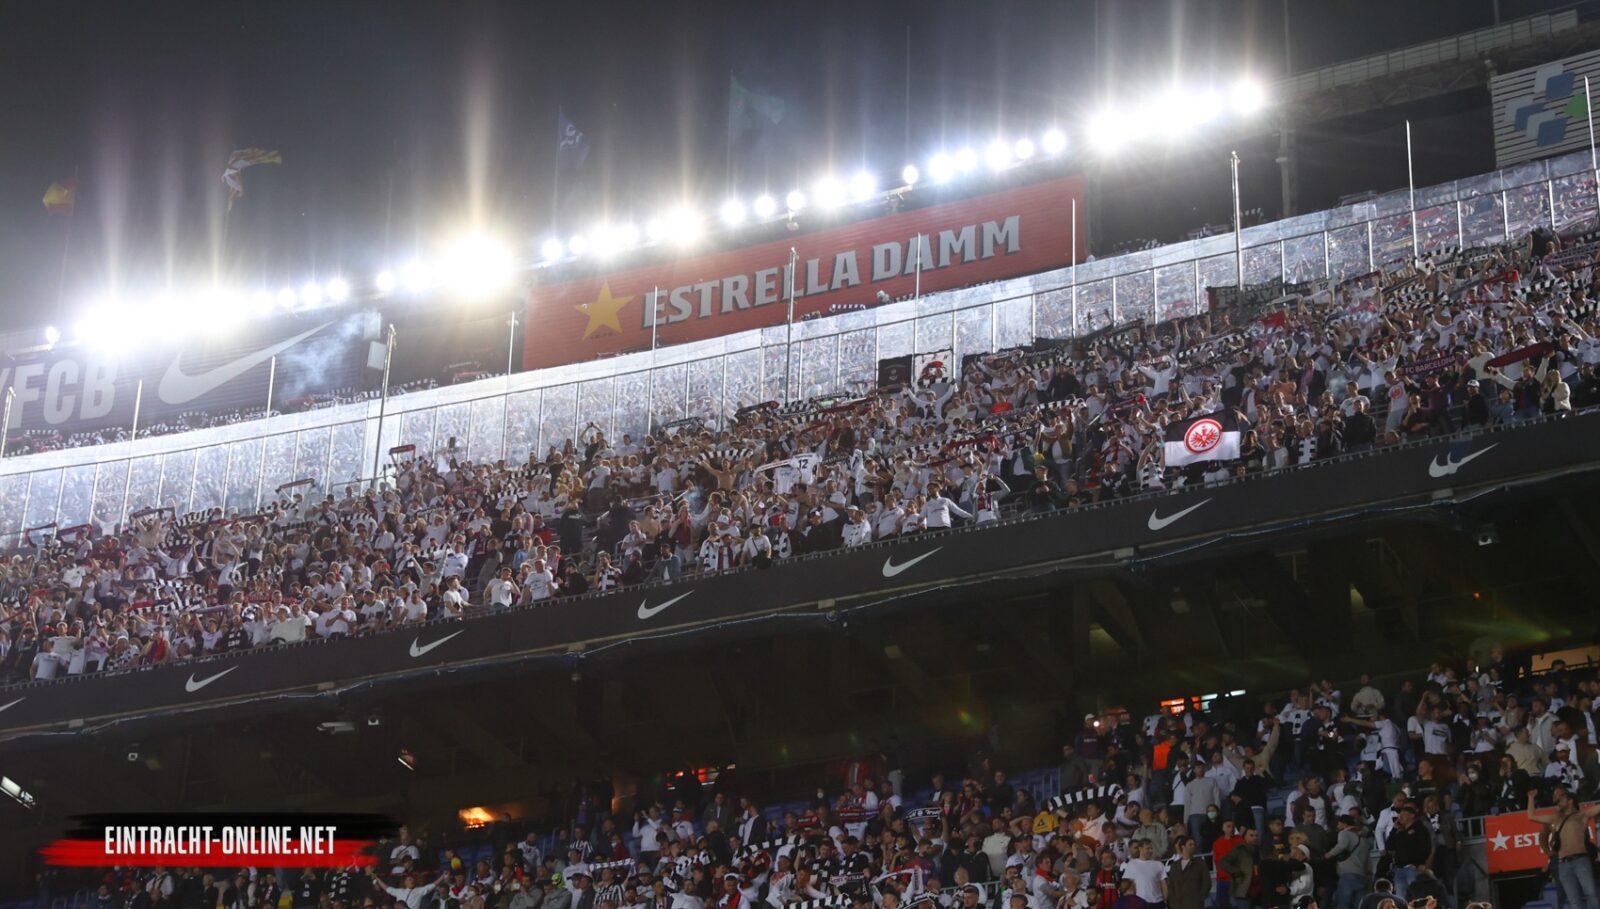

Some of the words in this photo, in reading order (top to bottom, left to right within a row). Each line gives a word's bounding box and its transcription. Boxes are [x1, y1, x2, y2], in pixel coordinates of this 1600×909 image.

[642, 250, 861, 328] ESTRELLA
[871, 214, 1021, 282] DAMM
[798, 458, 809, 469] 12
